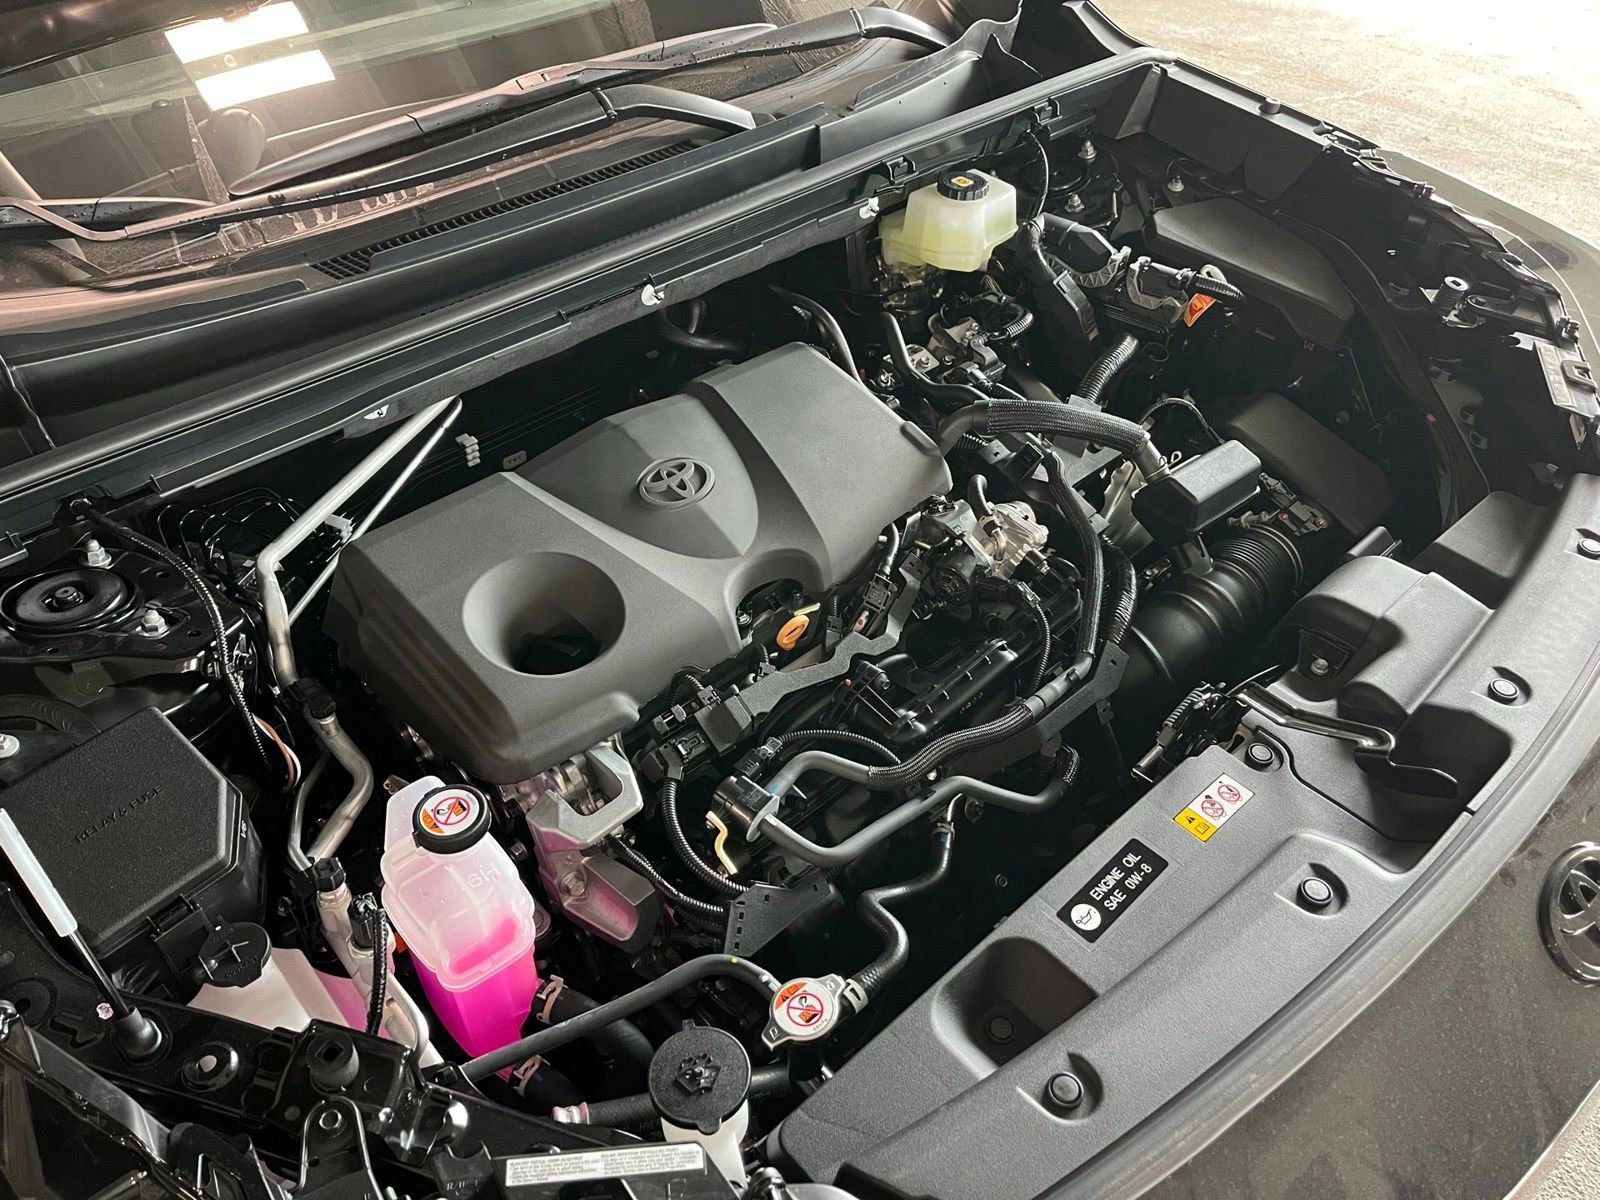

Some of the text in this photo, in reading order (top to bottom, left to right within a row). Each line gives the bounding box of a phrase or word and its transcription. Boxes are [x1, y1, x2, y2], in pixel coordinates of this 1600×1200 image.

[1089, 852, 1142, 901] ENGINE OIL
[1103, 863, 1152, 911] SAE 0W-8
